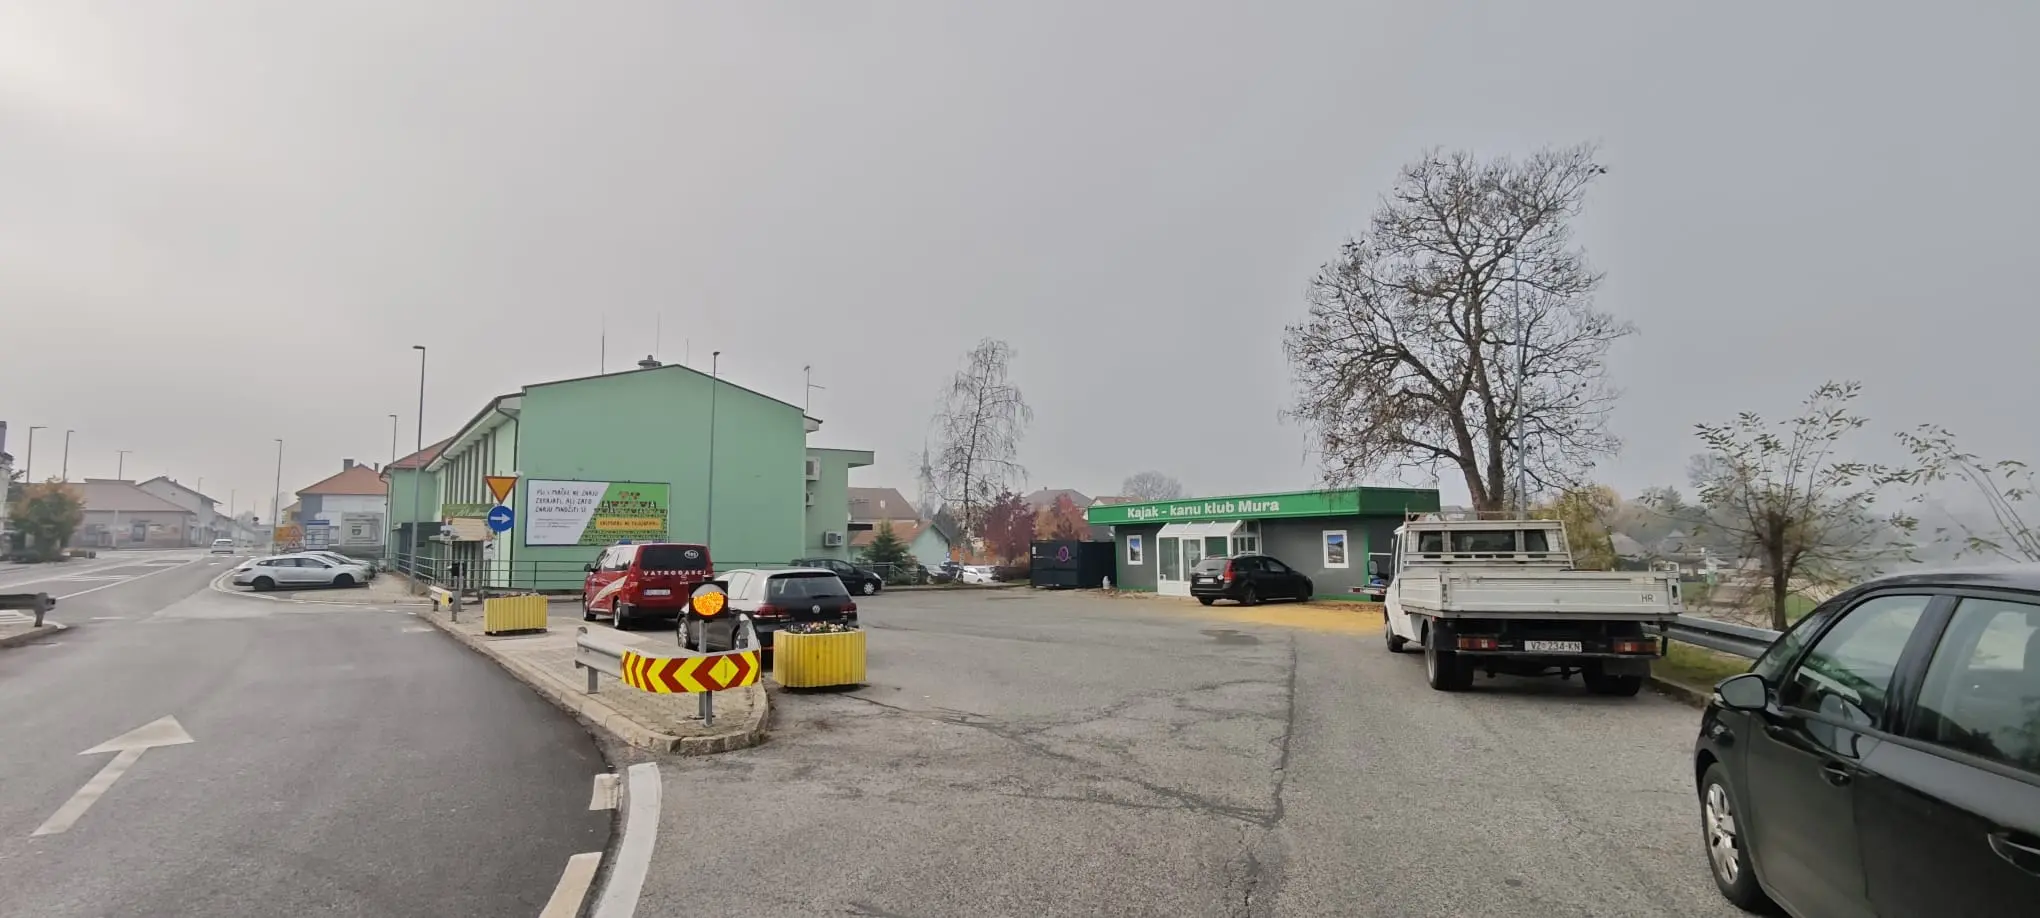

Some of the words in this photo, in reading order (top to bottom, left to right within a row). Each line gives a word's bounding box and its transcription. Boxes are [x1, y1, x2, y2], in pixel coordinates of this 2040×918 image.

[1127, 507, 1159, 520] Kajak
[1170, 504, 1201, 516] kanu
[1204, 502, 1235, 515] klub
[1238, 500, 1280, 513] Mura
[1641, 593, 1654, 603] HR
[1531, 641, 1542, 650] VZ
[1549, 641, 1581, 651] 234-KN
